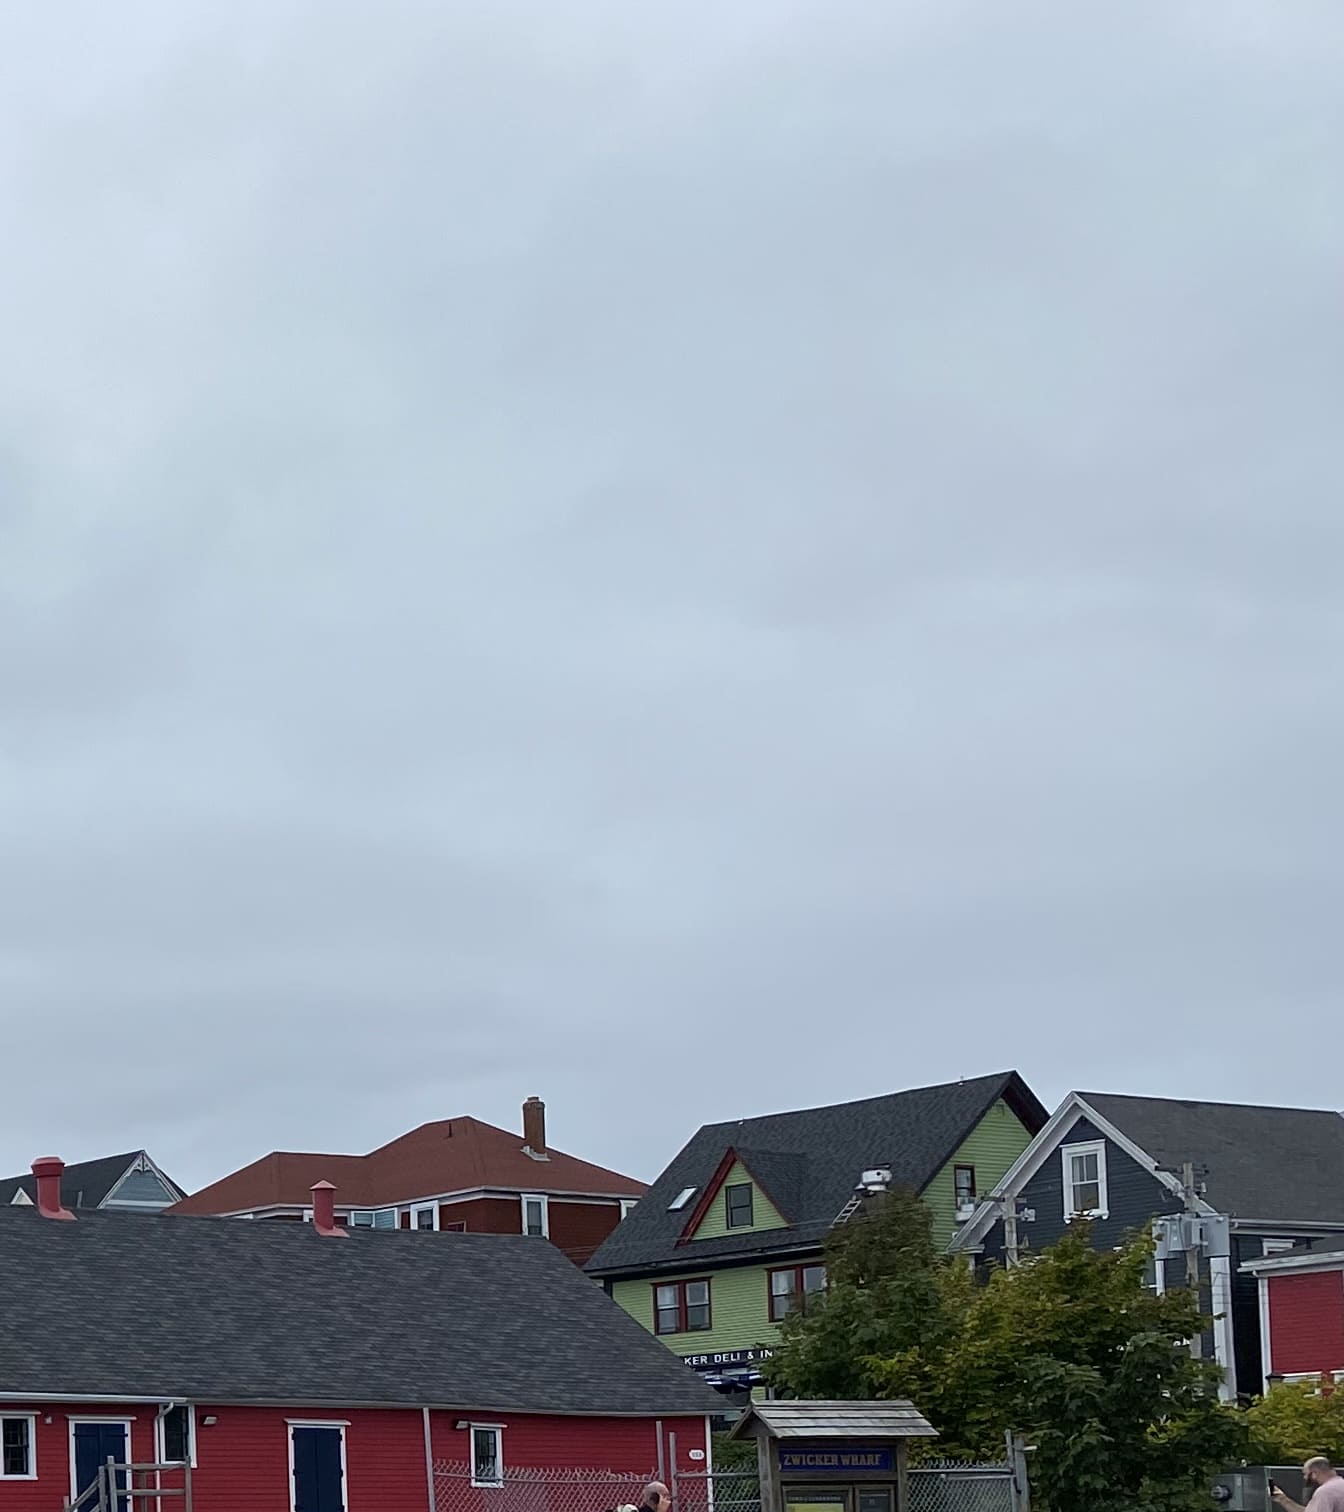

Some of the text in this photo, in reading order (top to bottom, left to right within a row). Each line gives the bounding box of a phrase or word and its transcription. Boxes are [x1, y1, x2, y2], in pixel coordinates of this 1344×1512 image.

[714, 1352, 741, 1363] DELI
[747, 1351, 754, 1360] &
[783, 1453, 882, 1466] ZWICKER WHARF
